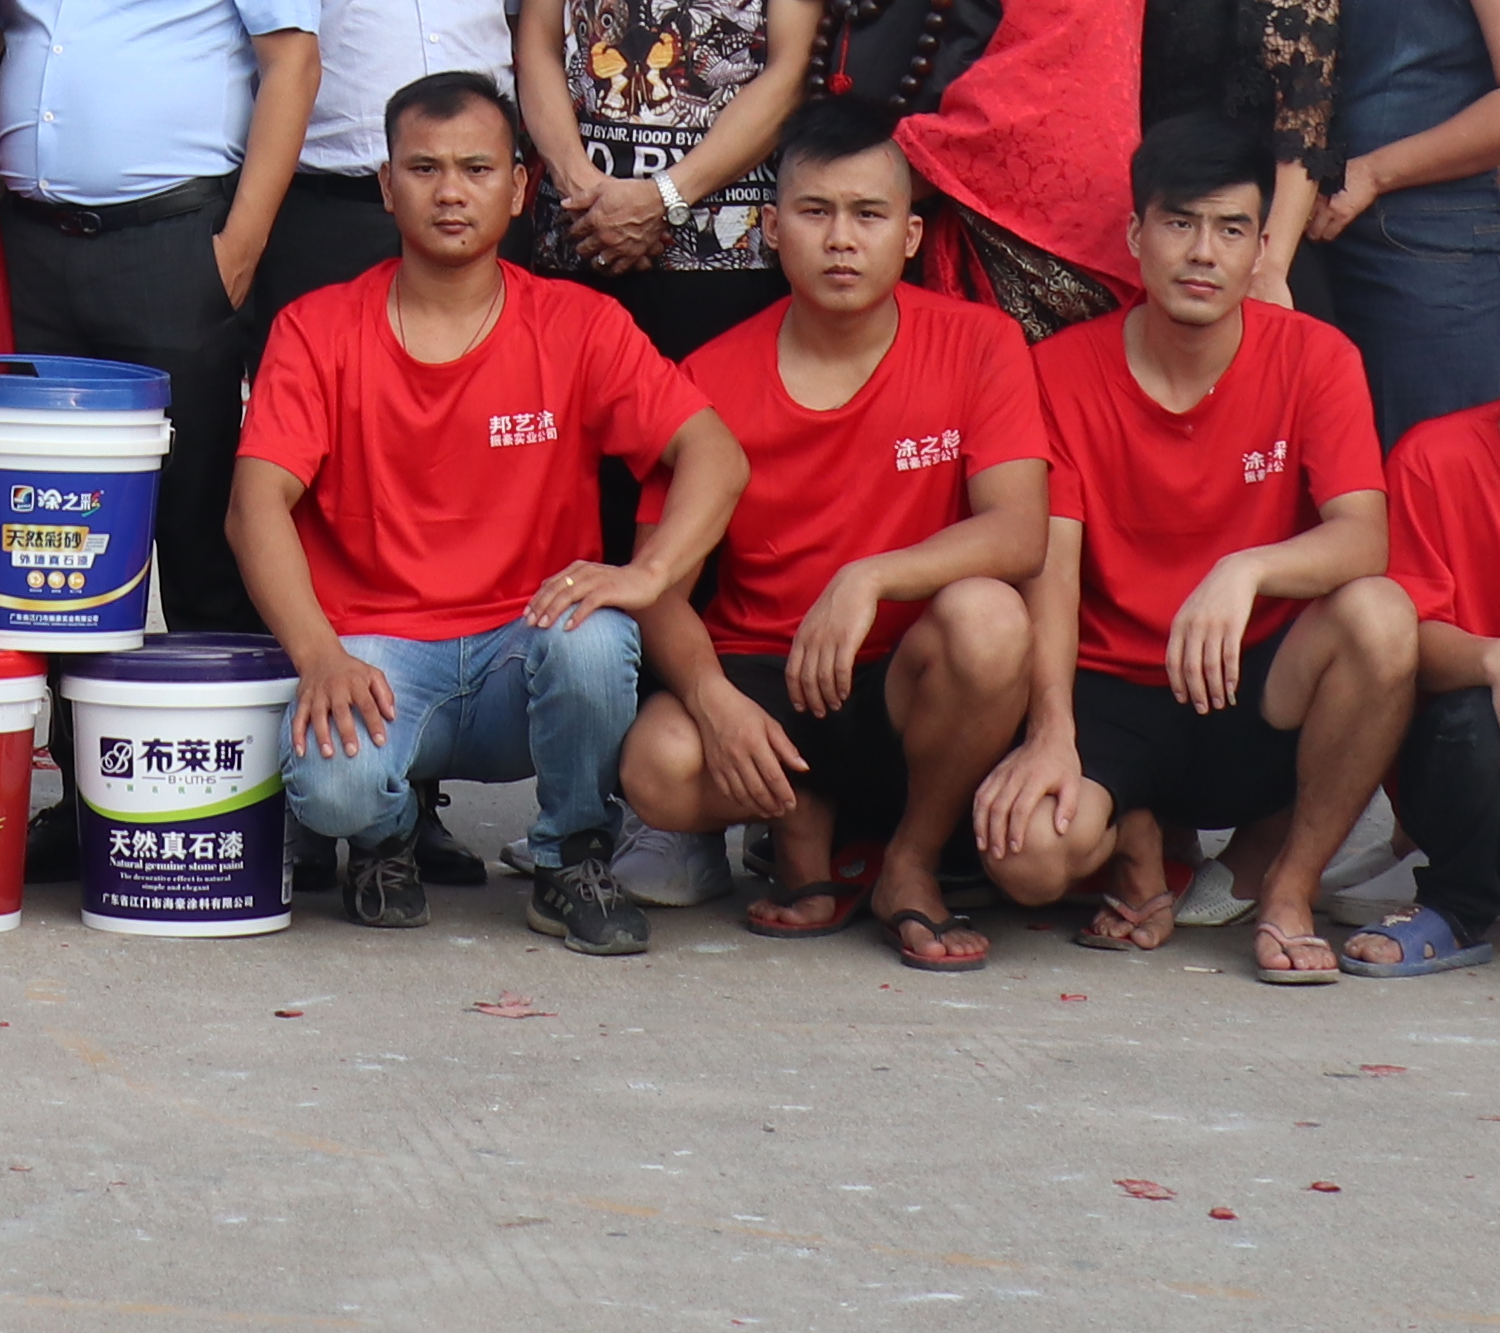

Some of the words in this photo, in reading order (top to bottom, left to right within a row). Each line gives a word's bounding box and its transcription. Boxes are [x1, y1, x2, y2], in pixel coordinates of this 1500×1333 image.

[632, 129, 672, 145] HOOD
[725, 188, 761, 202] HOOD
[894, 429, 961, 458] 涂之彩
[37, 488, 101, 517] 涂之彩
[6, 529, 81, 549] 天然彩砂
[137, 737, 245, 774] 布莱斯
[109, 829, 244, 860] 天然真石漆
[109, 856, 143, 870] Natural
[144, 860, 186, 872] genuine
[189, 860, 217, 871] stone
[219, 860, 244, 873] paint
